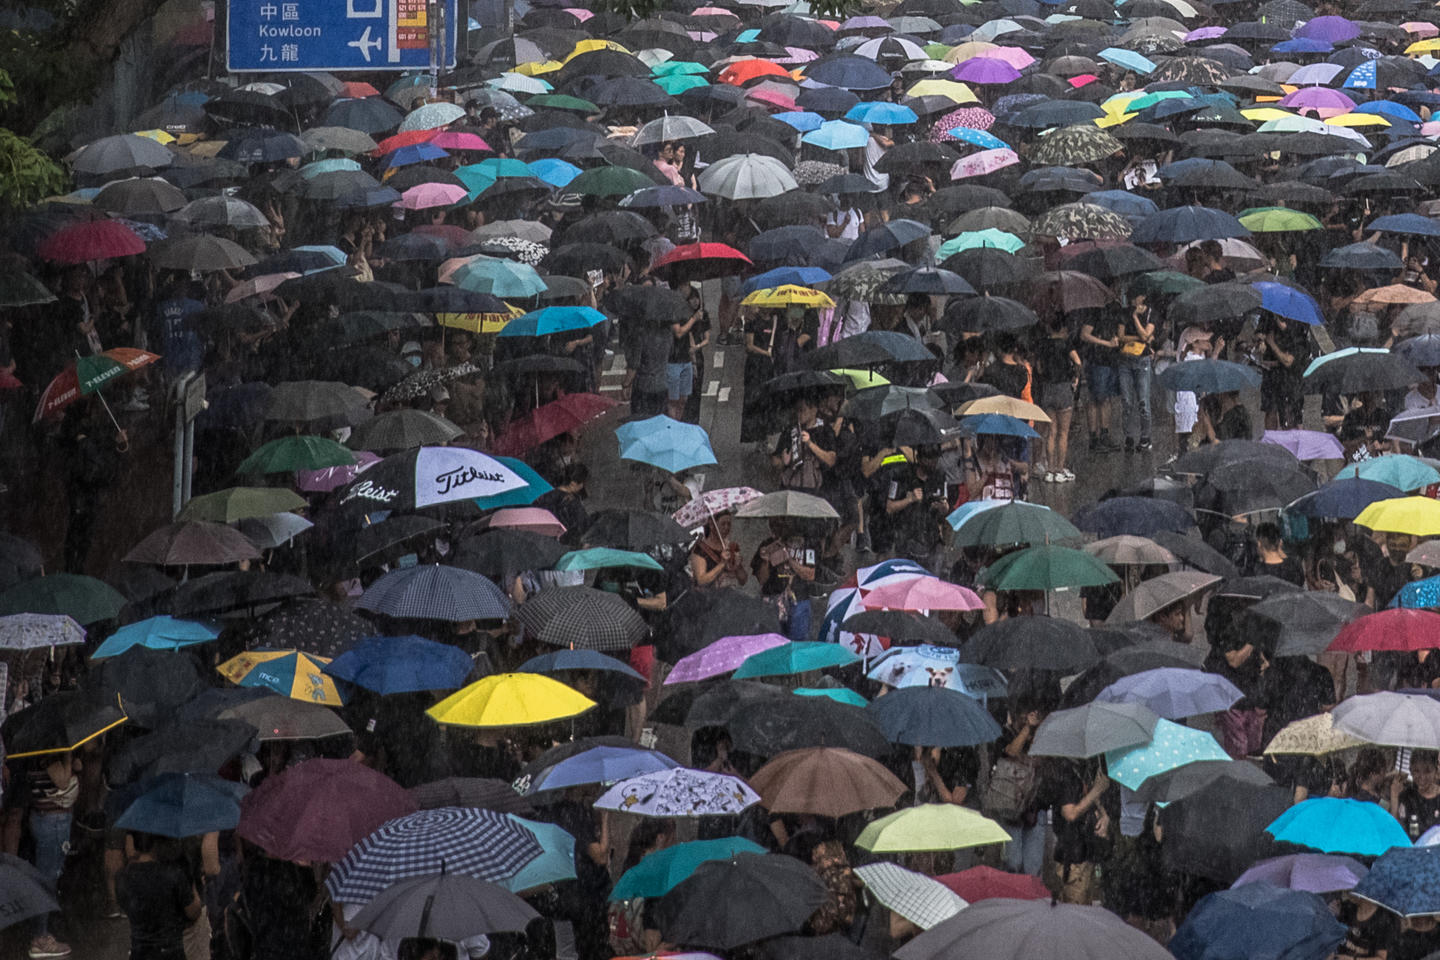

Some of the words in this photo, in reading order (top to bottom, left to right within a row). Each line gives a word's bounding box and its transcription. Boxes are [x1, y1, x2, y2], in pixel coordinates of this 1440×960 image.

[260, 2, 300, 21] 中區
[259, 24, 321, 37] Kowloon
[260, 43, 299, 61] 九龍
[435, 465, 505, 495] Titleist
